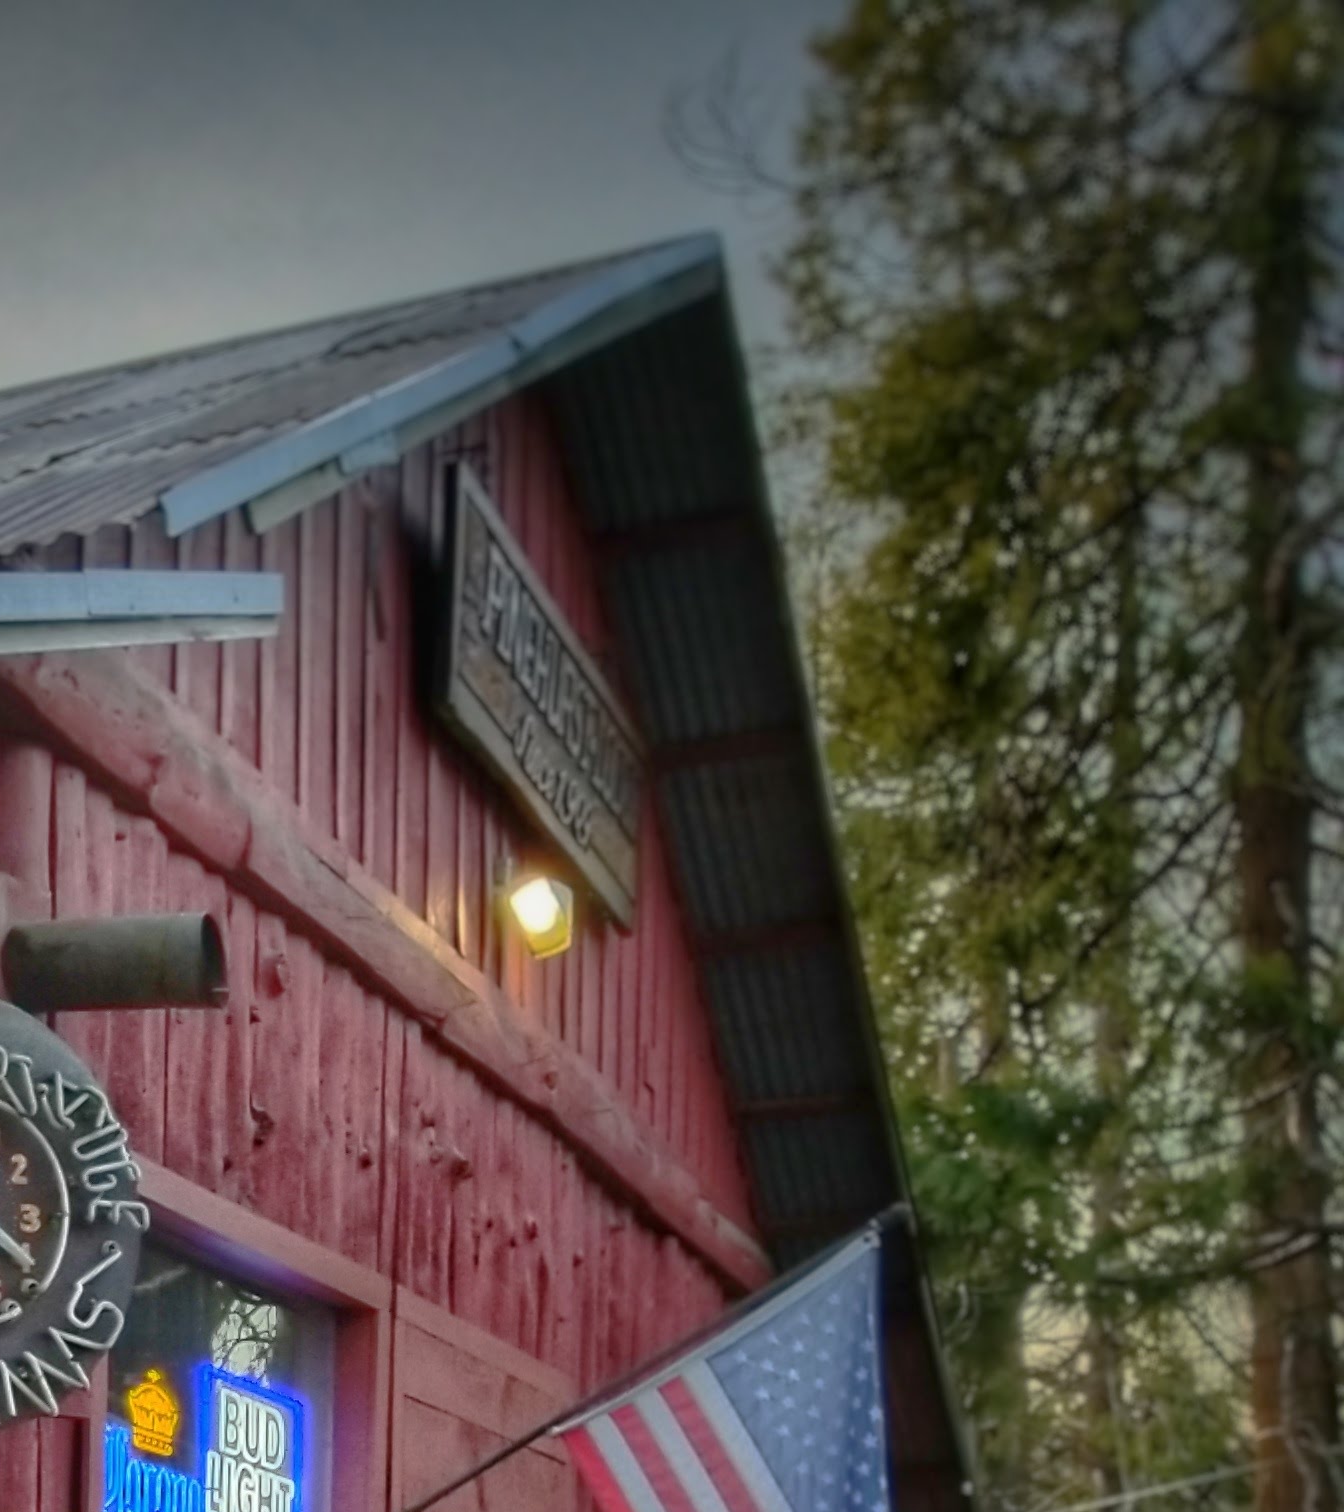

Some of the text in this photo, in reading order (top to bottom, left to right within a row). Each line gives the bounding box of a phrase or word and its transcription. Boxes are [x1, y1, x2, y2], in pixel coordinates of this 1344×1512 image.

[11, 1152, 29, 1185] 2
[19, 1203, 42, 1234] 3
[218, 1385, 285, 1470] BUD
